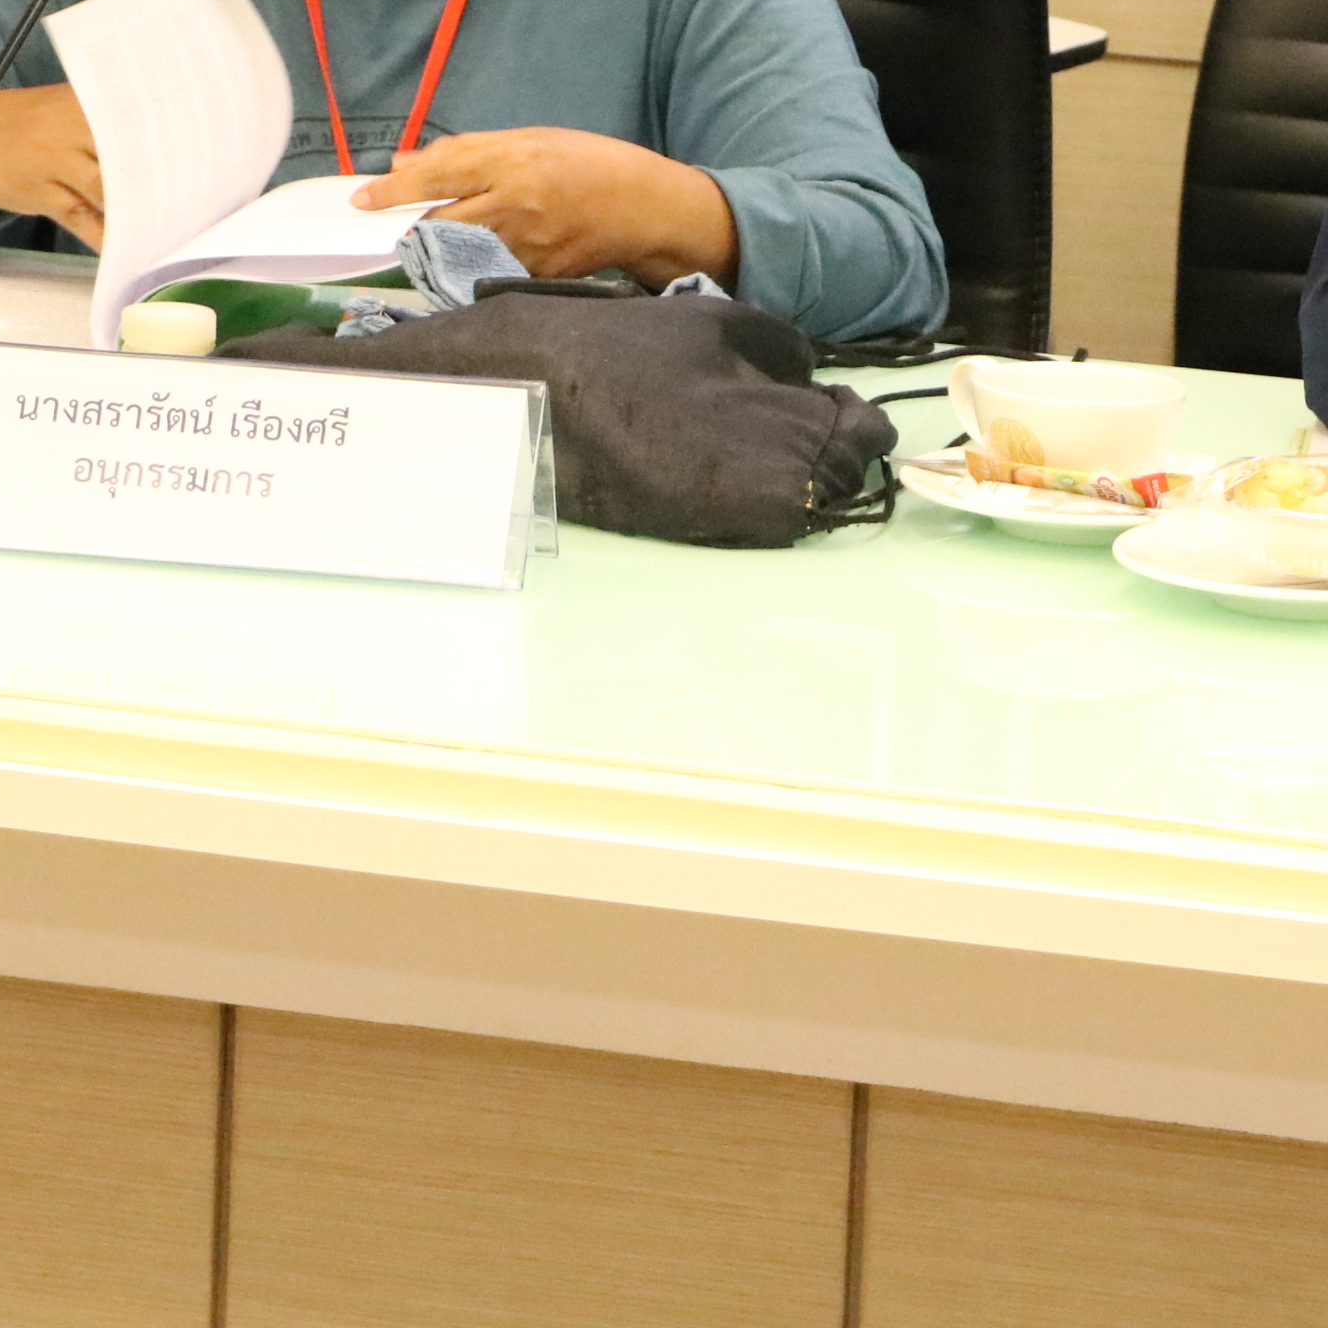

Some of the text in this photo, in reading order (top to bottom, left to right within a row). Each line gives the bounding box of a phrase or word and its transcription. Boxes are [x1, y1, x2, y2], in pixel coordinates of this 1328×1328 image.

[16, 391, 351, 447] นางสรารัตน์ เรืองศรี
[73, 457, 275, 498] อนุกรรมการ
